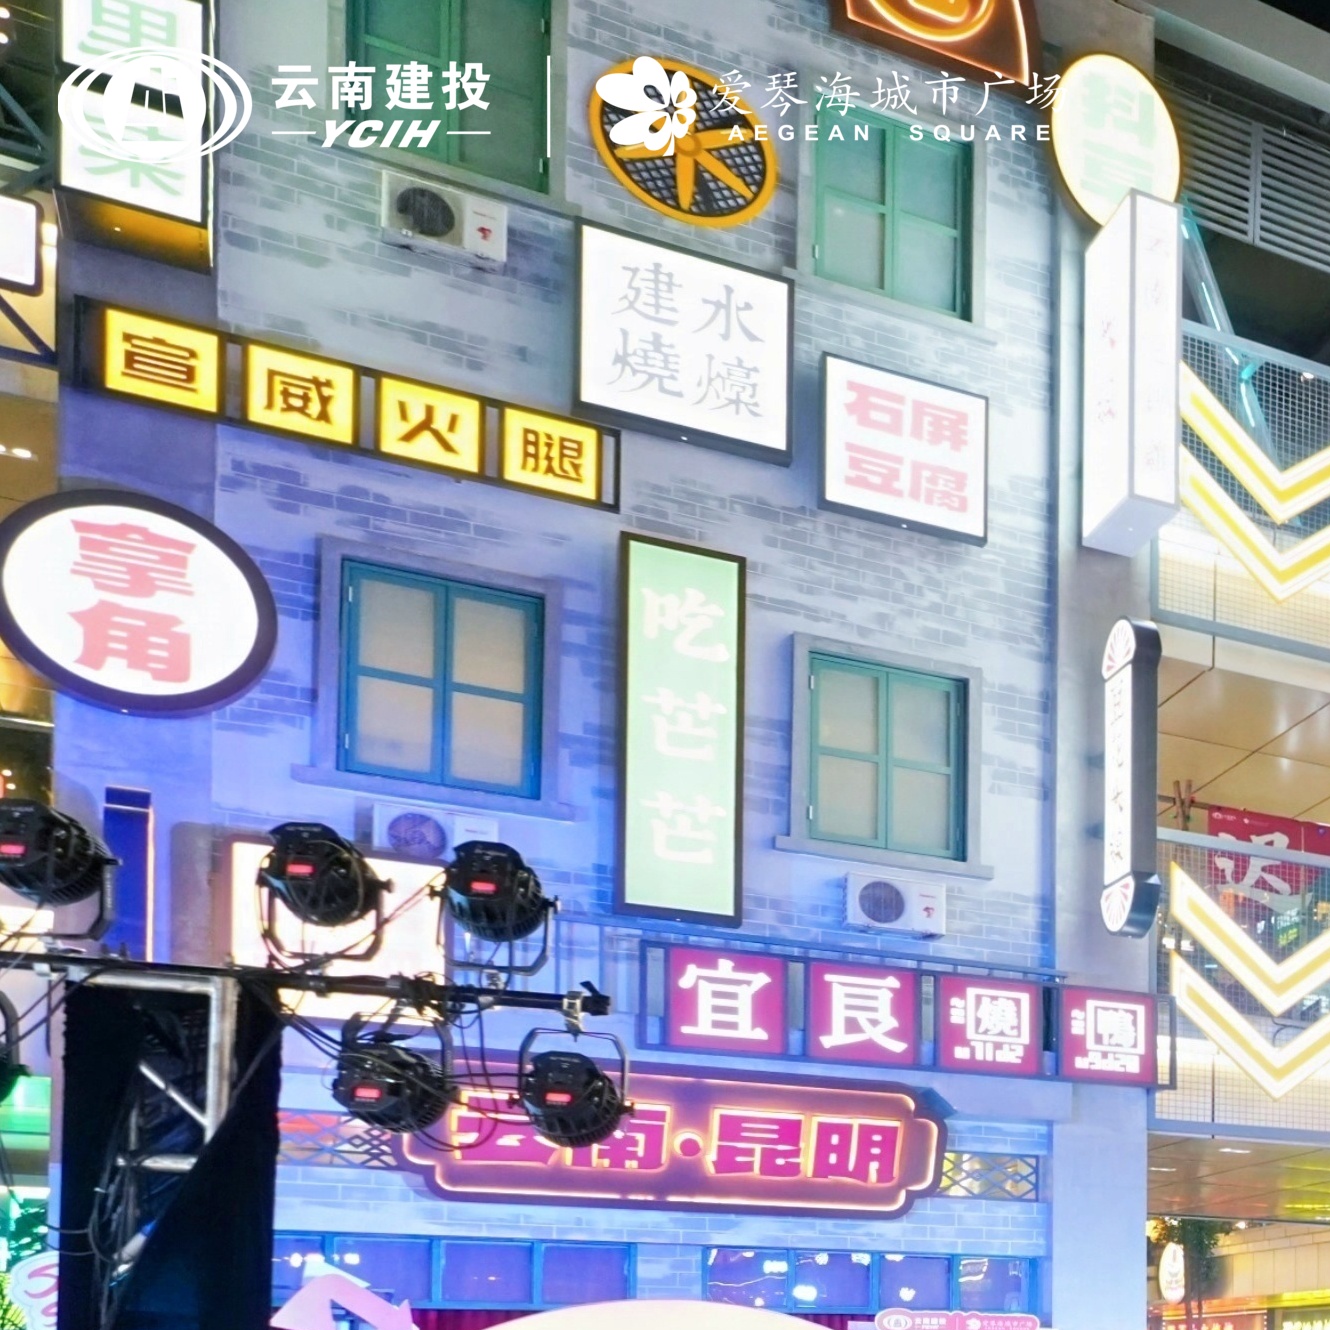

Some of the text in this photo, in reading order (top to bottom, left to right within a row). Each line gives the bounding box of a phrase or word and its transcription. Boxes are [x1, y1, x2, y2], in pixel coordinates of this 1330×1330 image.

[120, 333, 586, 484] 宣威火腿
[845, 378, 969, 455] 石屏
[844, 441, 969, 513] 豆腐
